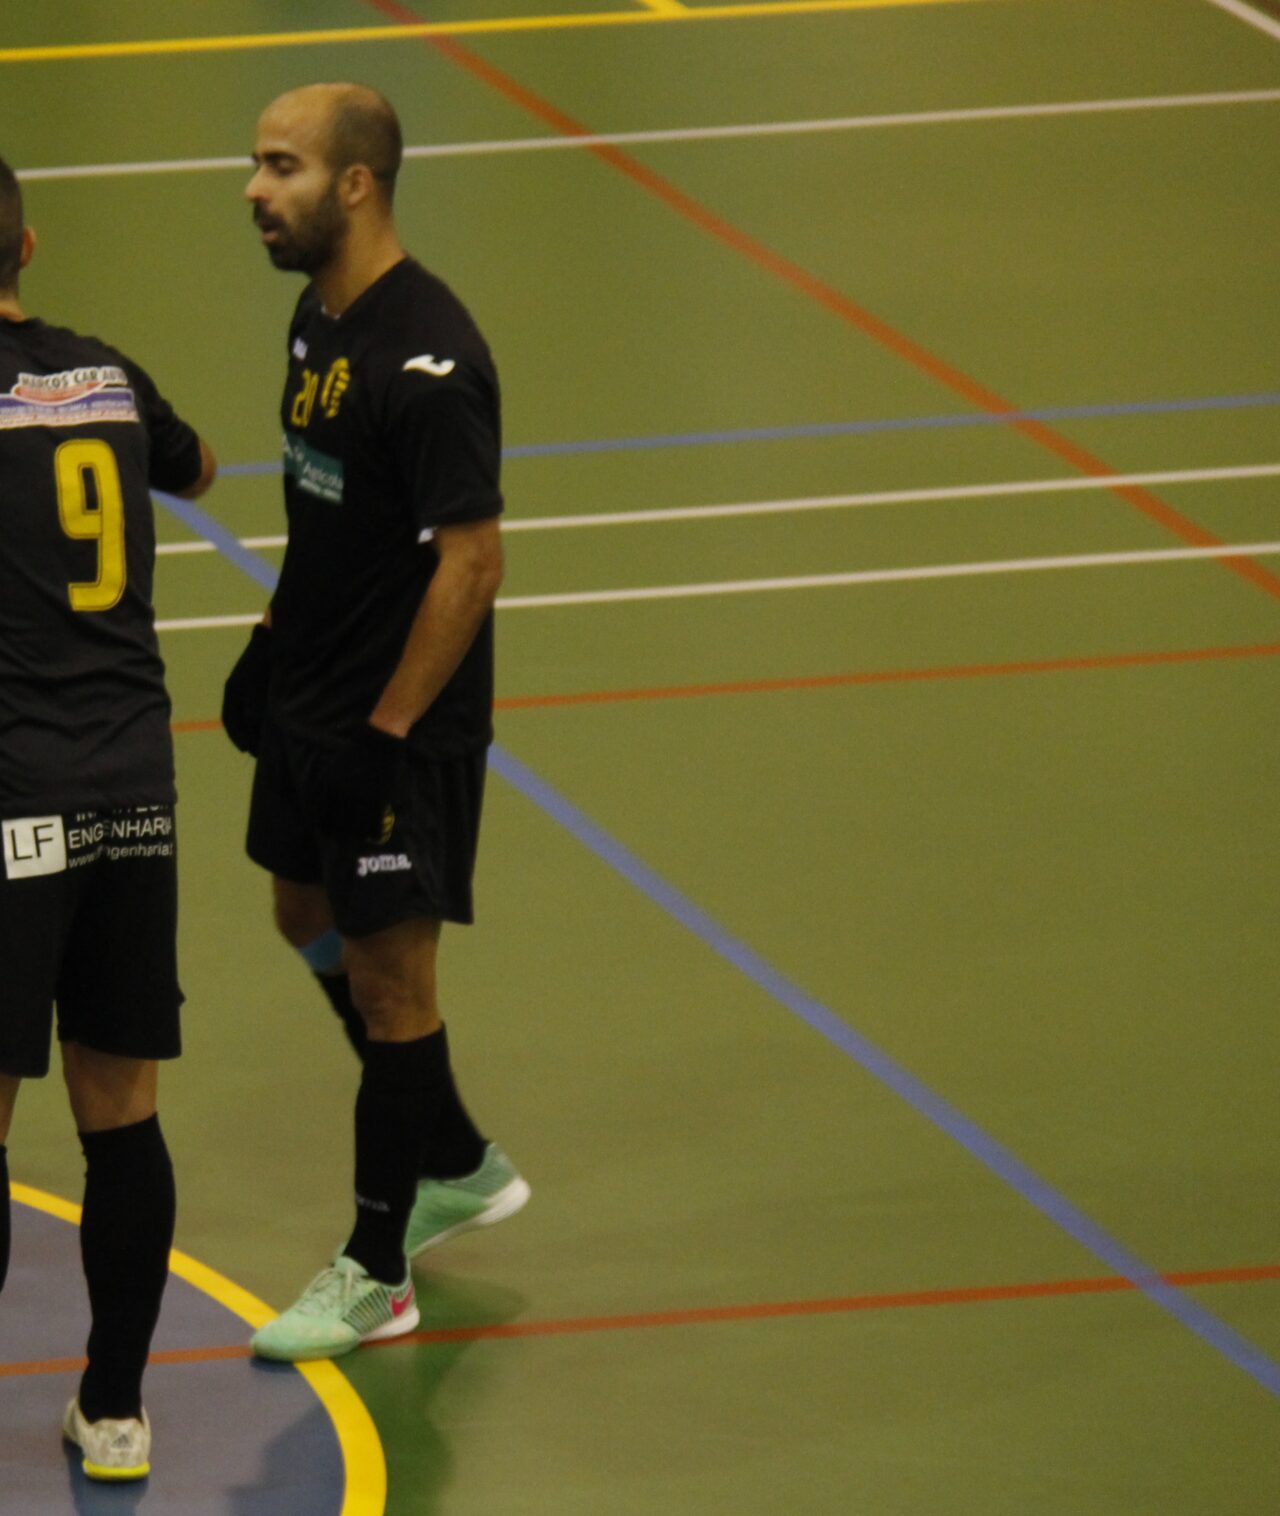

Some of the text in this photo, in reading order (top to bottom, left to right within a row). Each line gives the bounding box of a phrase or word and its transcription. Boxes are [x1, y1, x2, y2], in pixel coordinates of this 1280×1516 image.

[22, 375, 69, 388] MARCOS
[74, 369, 98, 382] CAR
[54, 438, 127, 612] 9
[11, 823, 54, 862] LF
